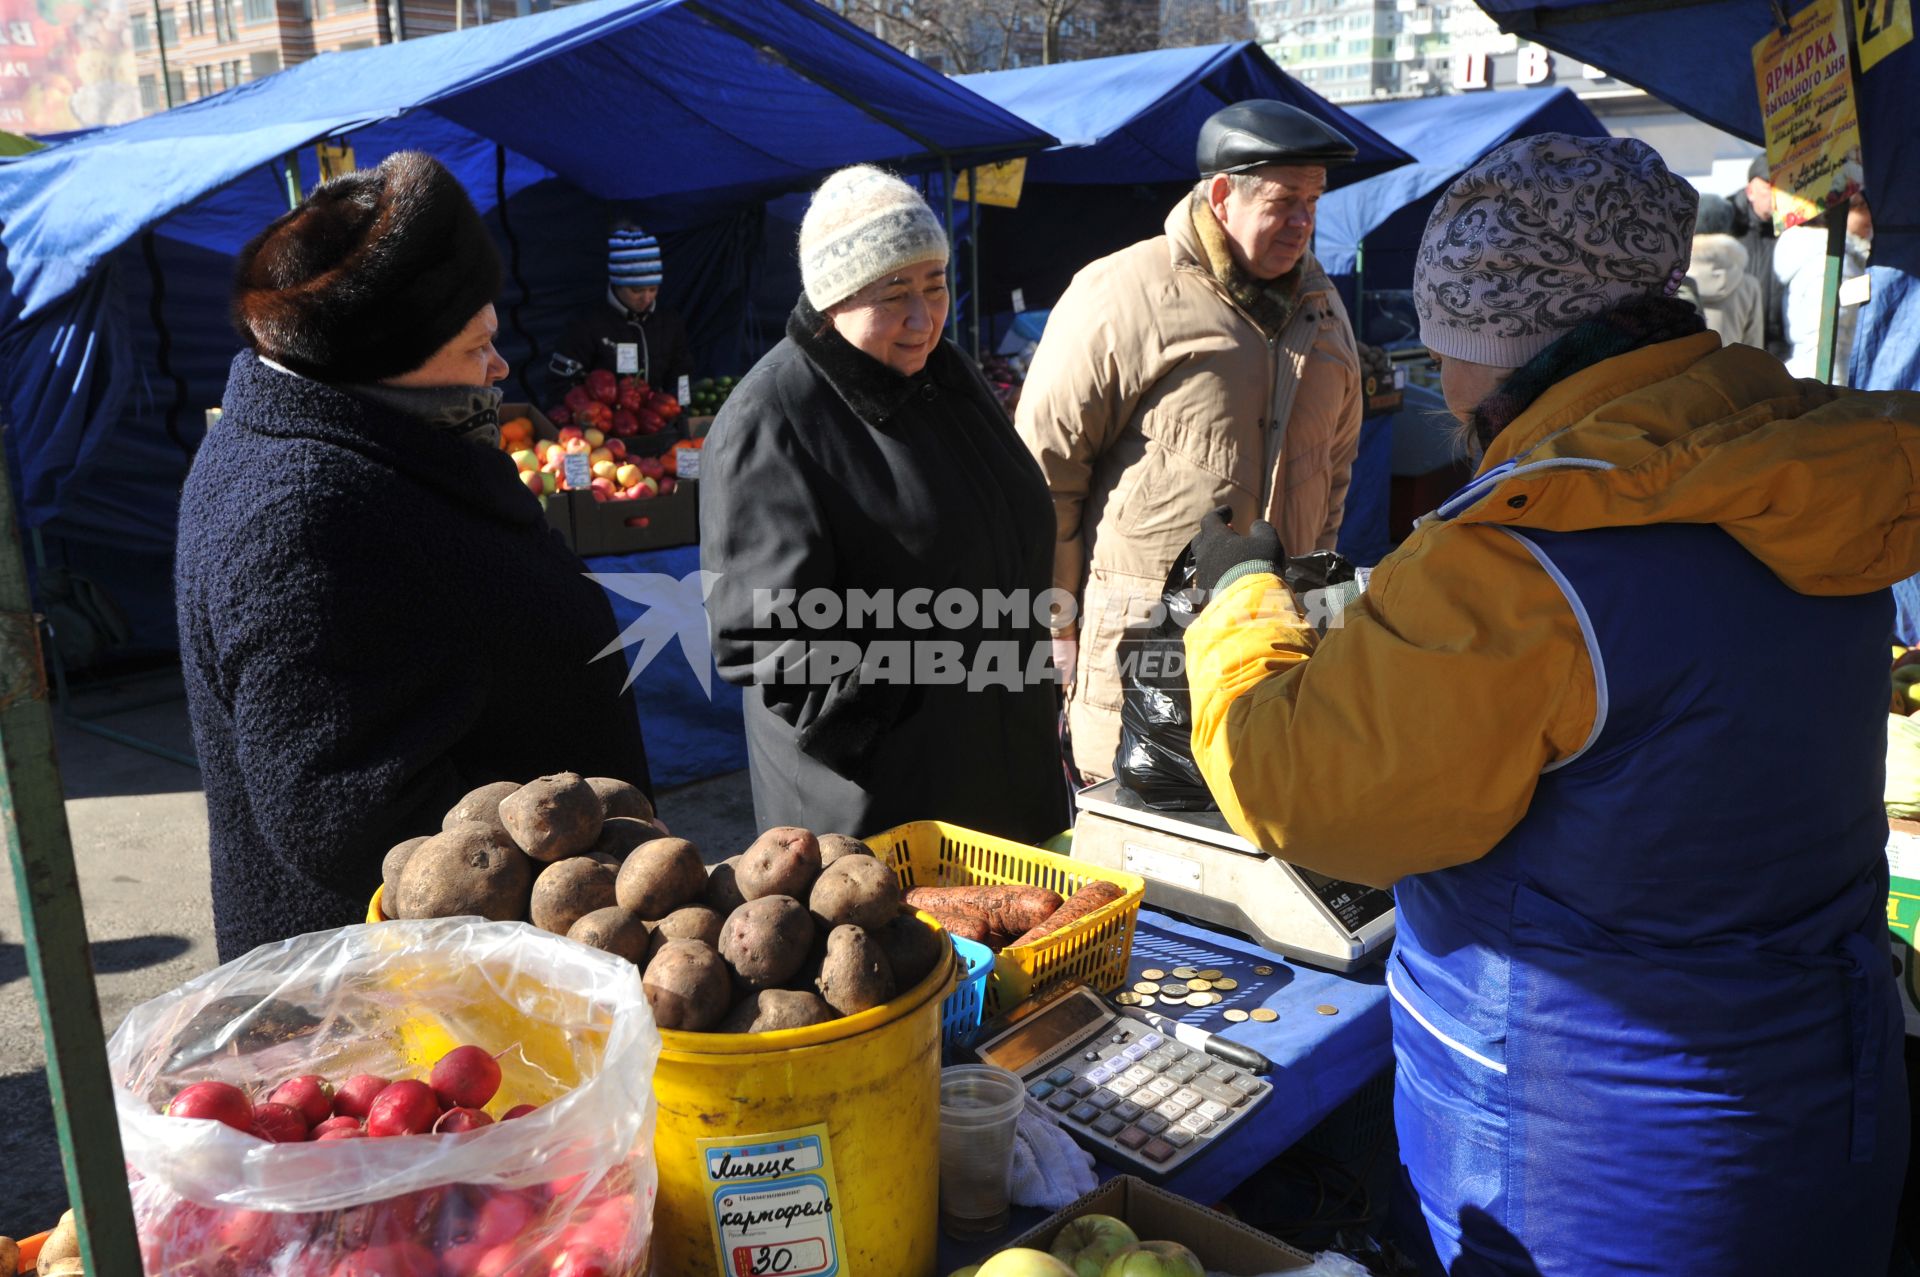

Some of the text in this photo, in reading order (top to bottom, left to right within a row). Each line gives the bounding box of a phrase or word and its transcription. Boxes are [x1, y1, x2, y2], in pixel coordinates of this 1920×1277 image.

[1766, 31, 1838, 96] ЯРМАРКА
[1765, 54, 1846, 118] ВЫХОДНОГО ДНЯ
[1330, 893, 1351, 909] CAS
[711, 1154, 795, 1180] Липецк
[720, 1198, 834, 1235] картофель
